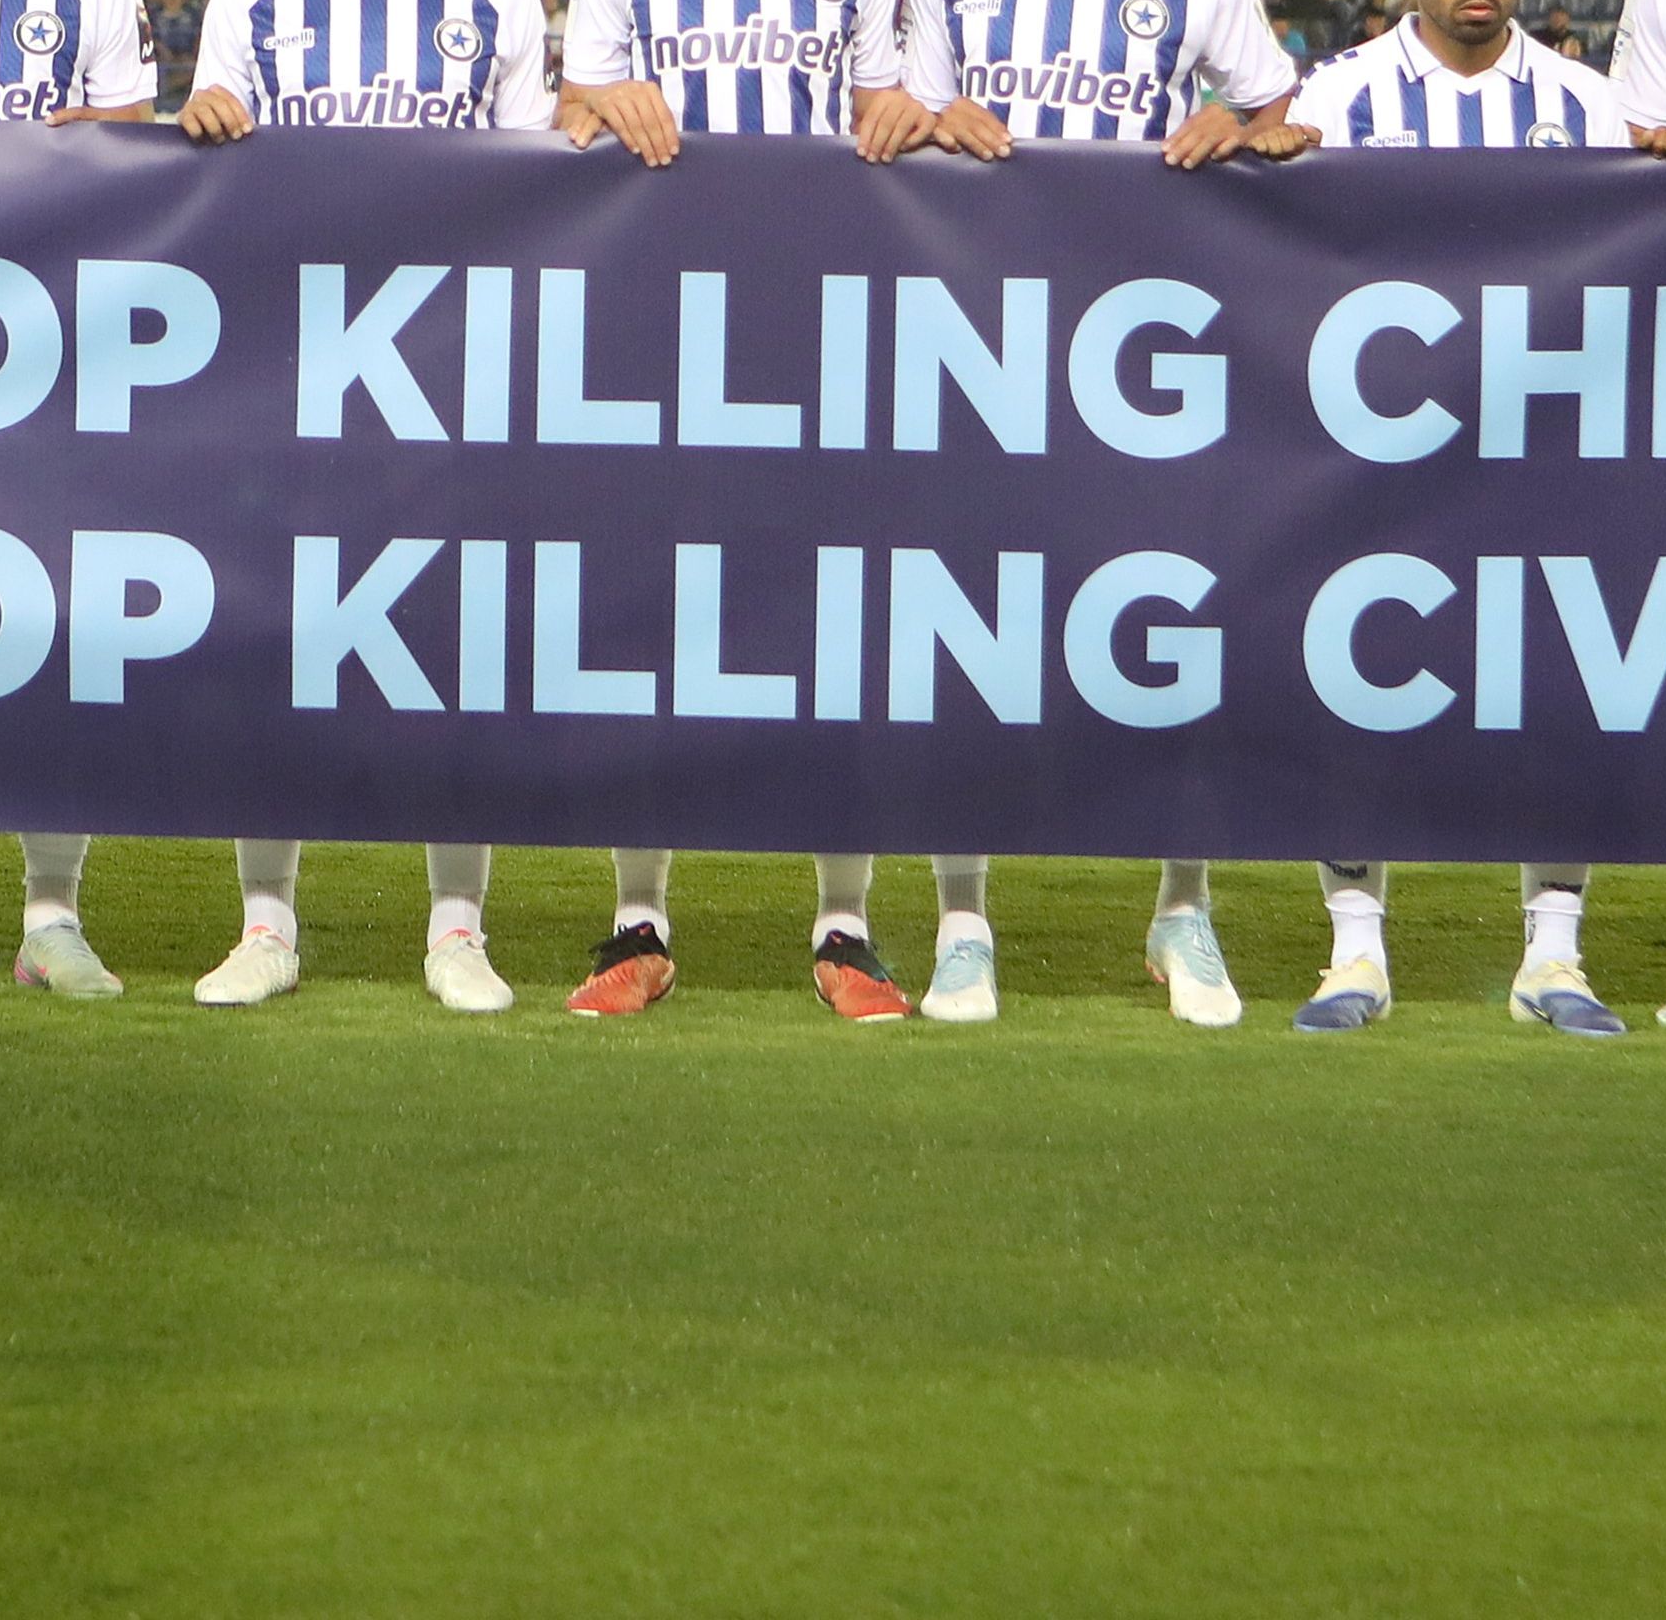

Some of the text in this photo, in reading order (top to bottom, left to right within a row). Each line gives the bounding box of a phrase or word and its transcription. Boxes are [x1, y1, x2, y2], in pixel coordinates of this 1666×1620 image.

[656, 19, 840, 73] novibet
[284, 79, 470, 128] novibet
[966, 58, 1154, 114] novibet
[296, 263, 1229, 459] KILLING
[291, 535, 1223, 729] KILLING
